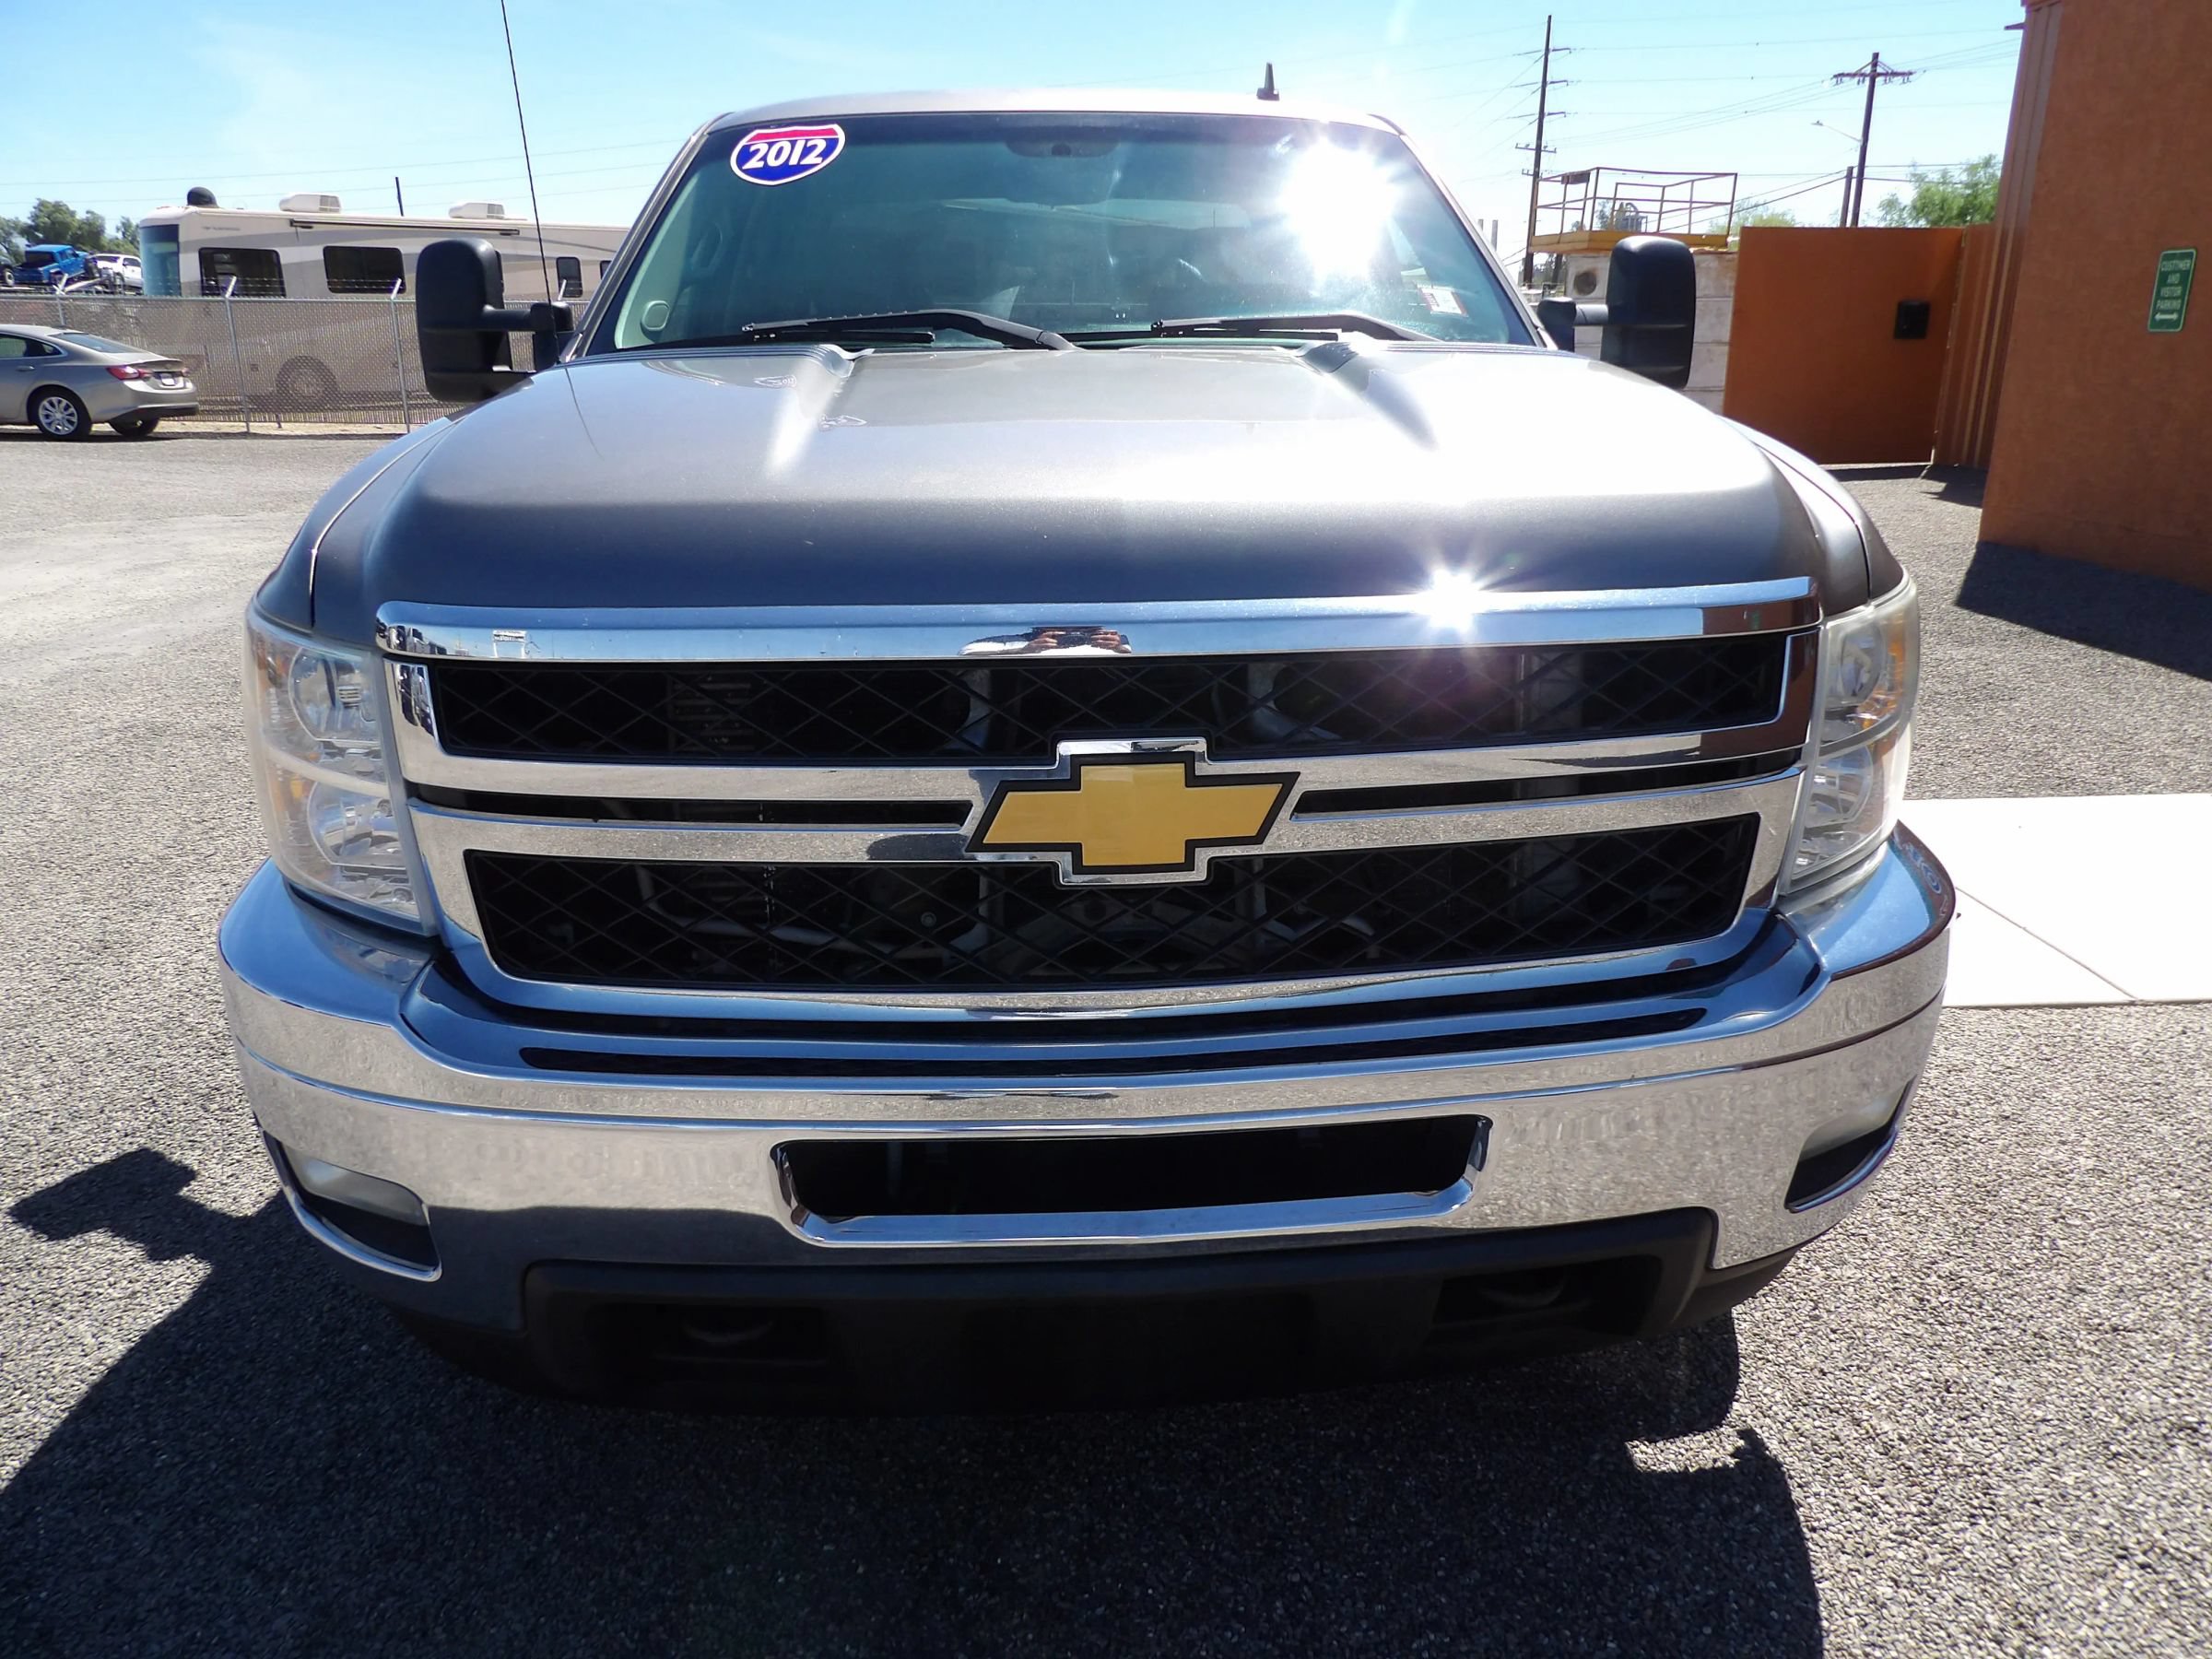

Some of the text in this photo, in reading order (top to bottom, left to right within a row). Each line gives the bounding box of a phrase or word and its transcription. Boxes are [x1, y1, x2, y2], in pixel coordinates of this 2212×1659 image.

[742, 138, 827, 170] 2012
[2167, 273, 2181, 285] AND
[2160, 287, 2183, 297] VISITOR
[2156, 300, 2182, 310] PARKING
